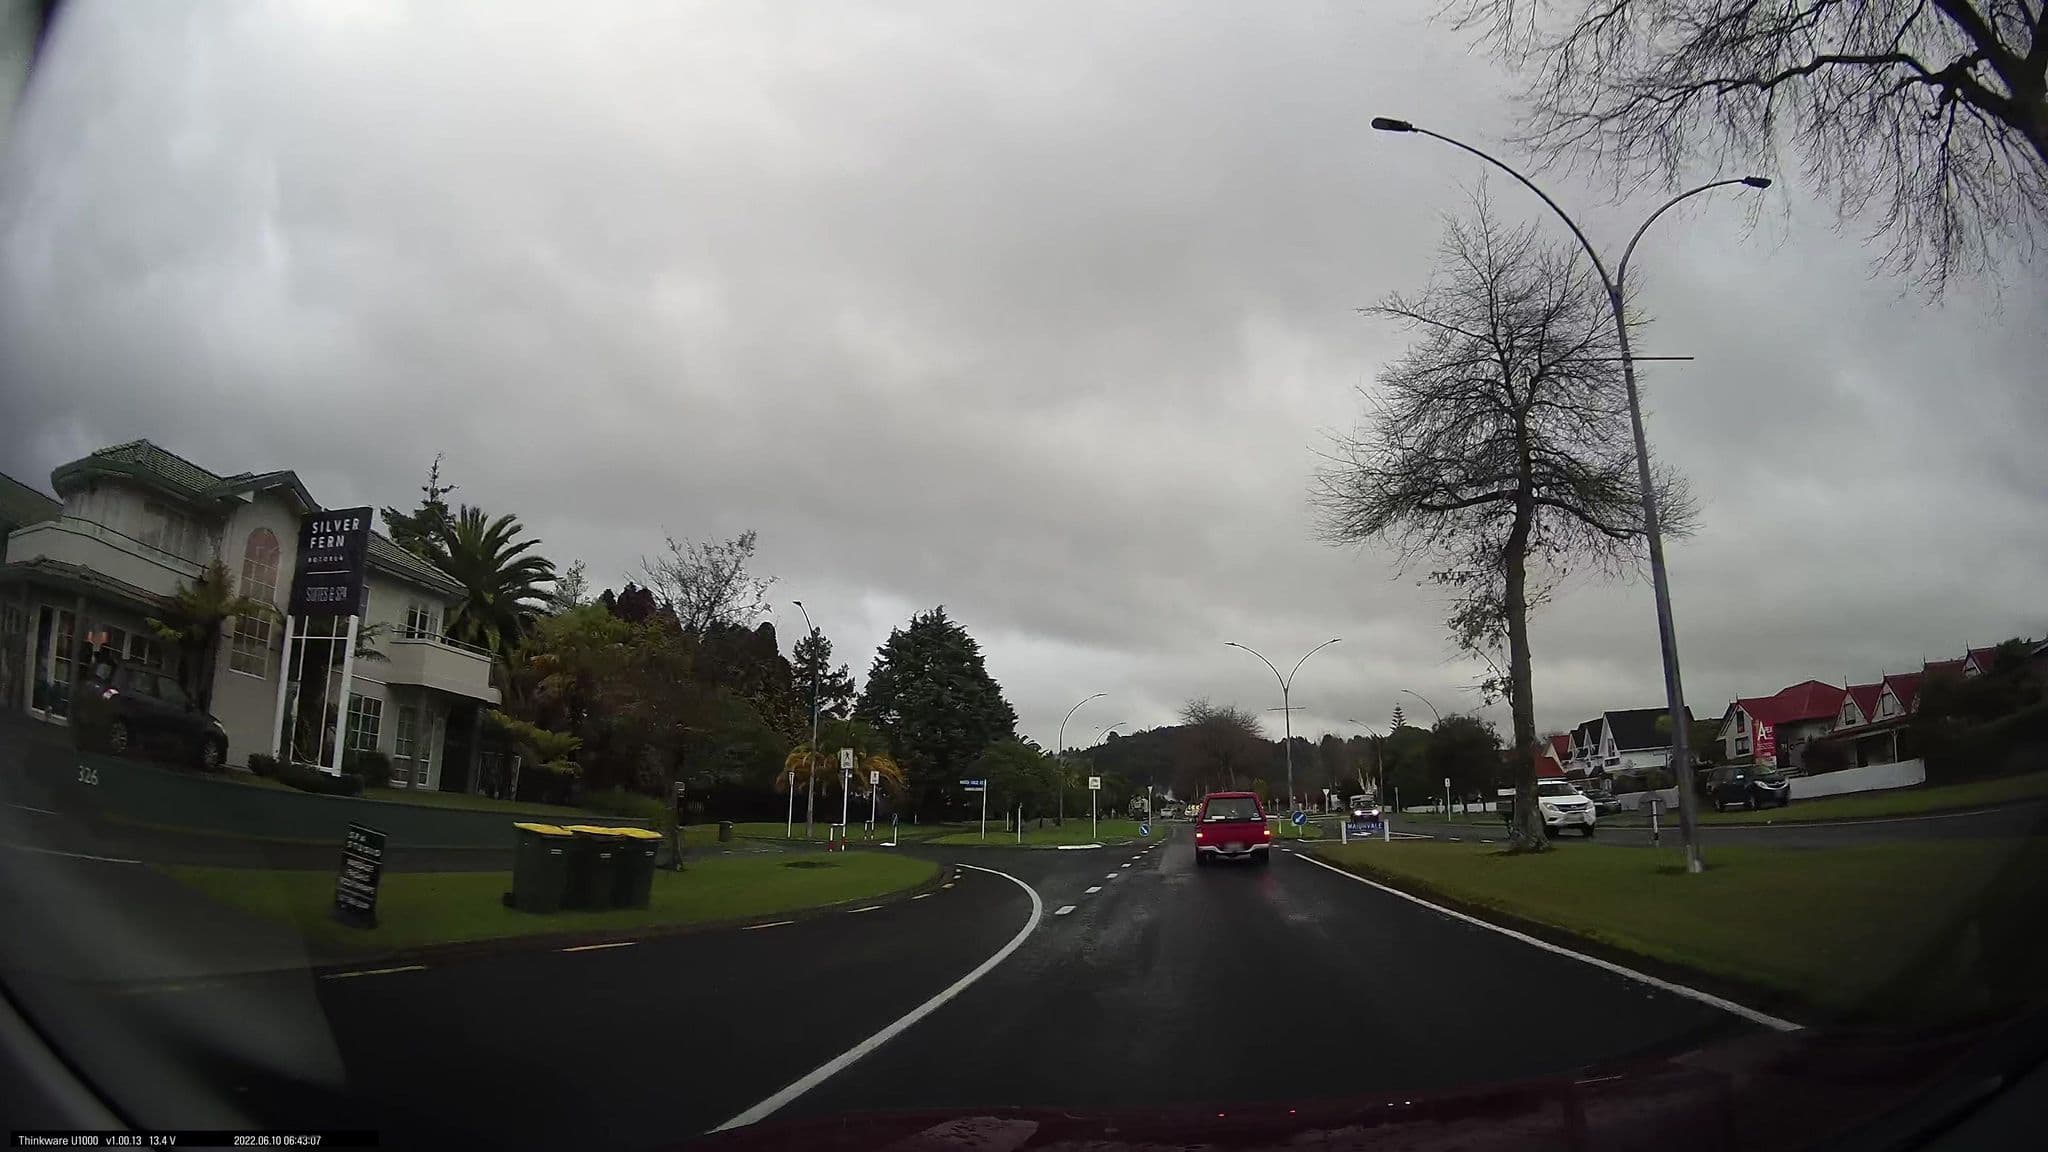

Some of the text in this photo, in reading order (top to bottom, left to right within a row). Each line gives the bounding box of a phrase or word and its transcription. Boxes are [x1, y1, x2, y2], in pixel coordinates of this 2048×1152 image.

[312, 518, 360, 534] SILVER
[310, 535, 345, 549] FERN
[77, 765, 98, 786] 326
